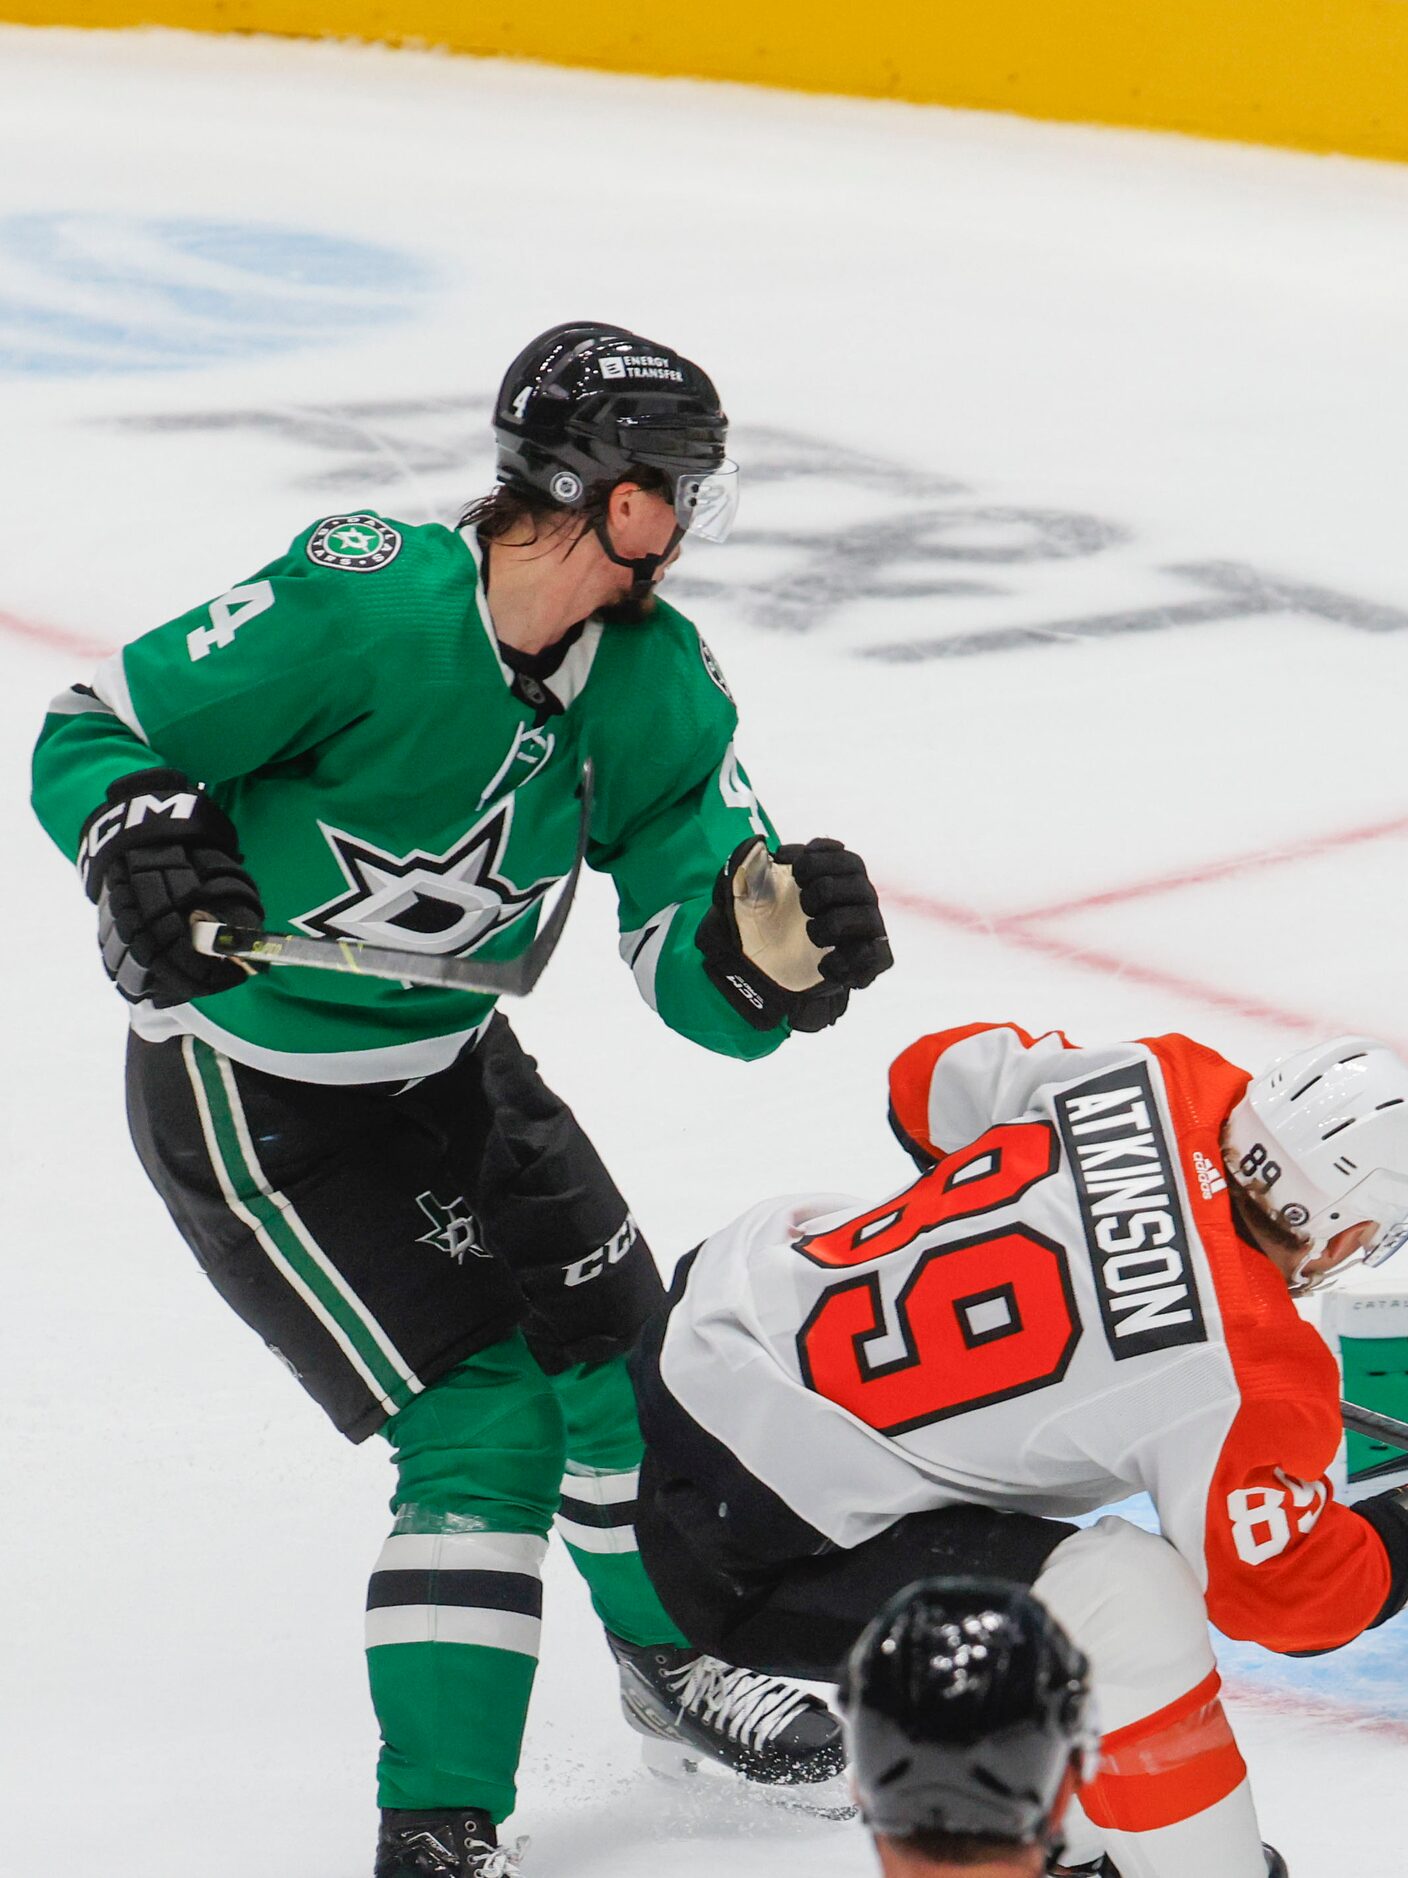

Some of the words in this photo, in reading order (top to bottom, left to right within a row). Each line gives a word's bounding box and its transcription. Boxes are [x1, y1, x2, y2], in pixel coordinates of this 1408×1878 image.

[623, 356, 669, 368] ENERGY
[626, 367, 683, 382] TRANSFER
[512, 386, 533, 418] 4
[186, 579, 275, 662] 4
[726, 975, 764, 1009] CCM
[1192, 1151, 1213, 1200] adidas
[1239, 1142, 1282, 1195] 89
[1066, 1086, 1194, 1338] ATKINSON
[791, 1119, 1084, 1438] 89
